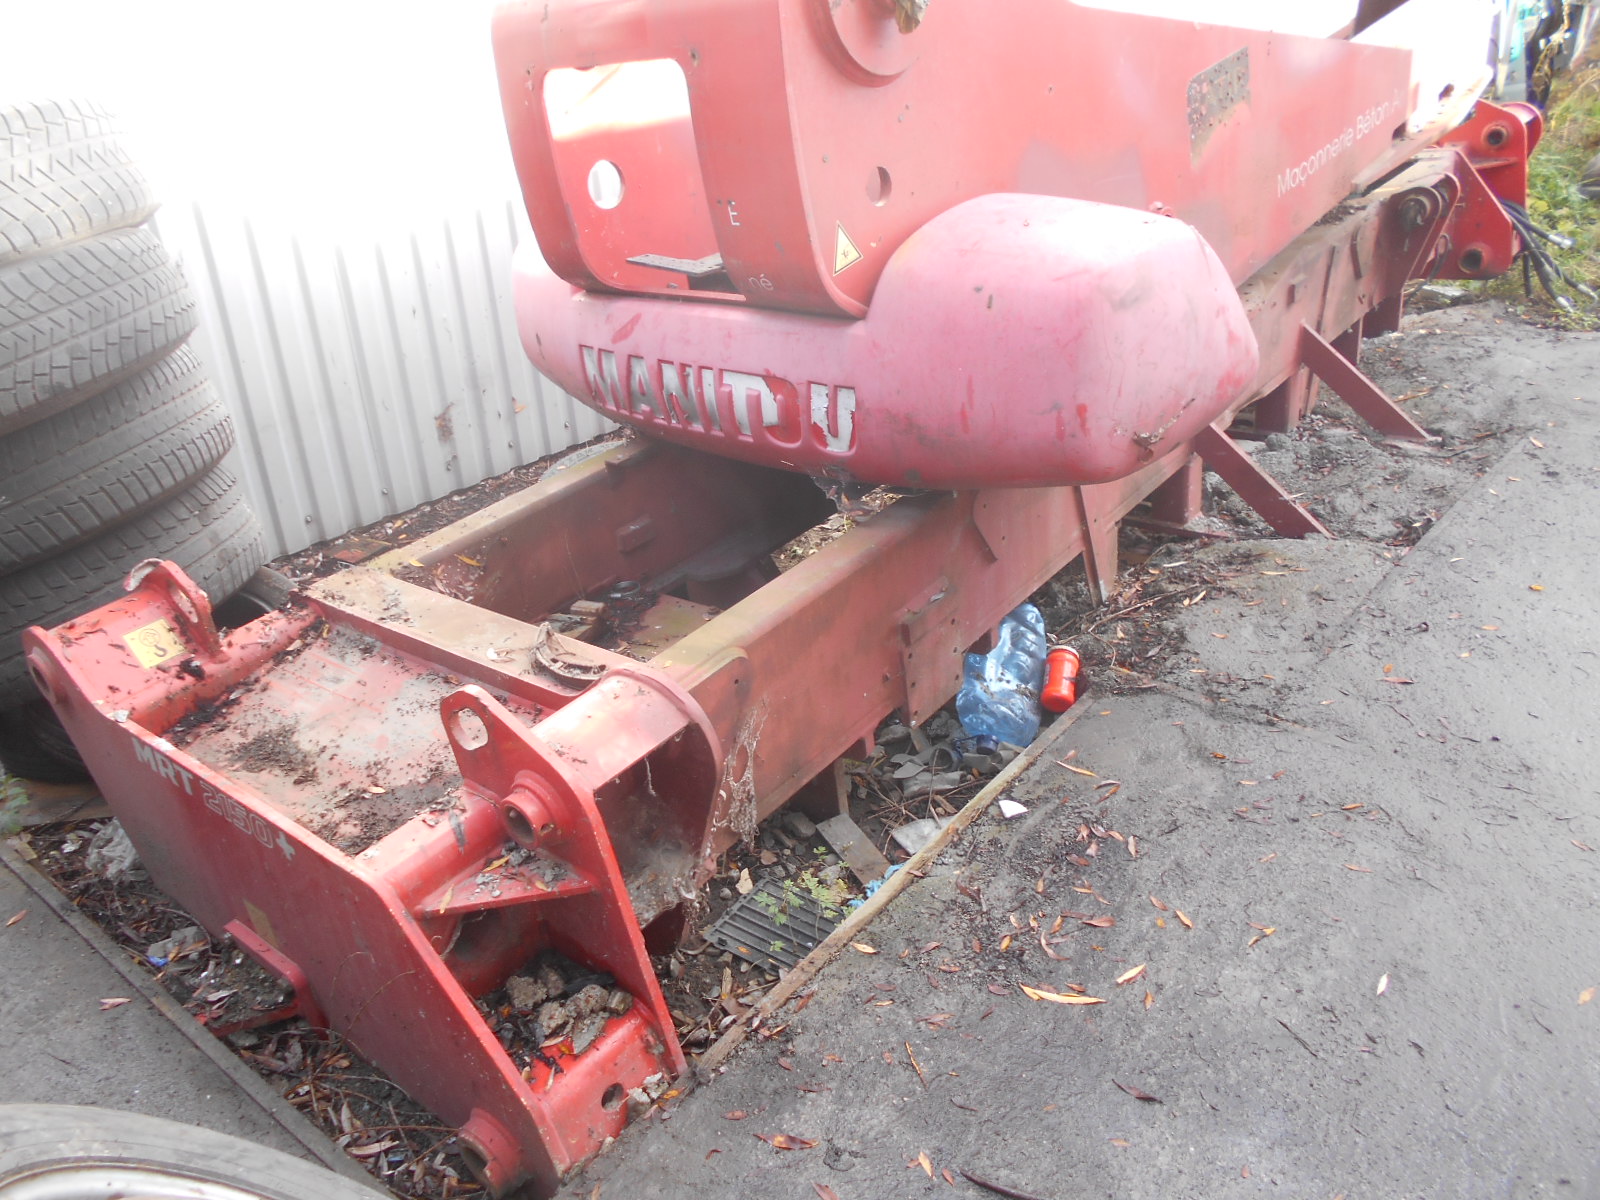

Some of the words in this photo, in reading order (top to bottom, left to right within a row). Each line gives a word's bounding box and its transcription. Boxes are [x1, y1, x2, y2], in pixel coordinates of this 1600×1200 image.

[1277, 127, 1354, 198] Maçonnerie
[579, 344, 857, 457] MANITOU
[131, 736, 195, 796] MRT
